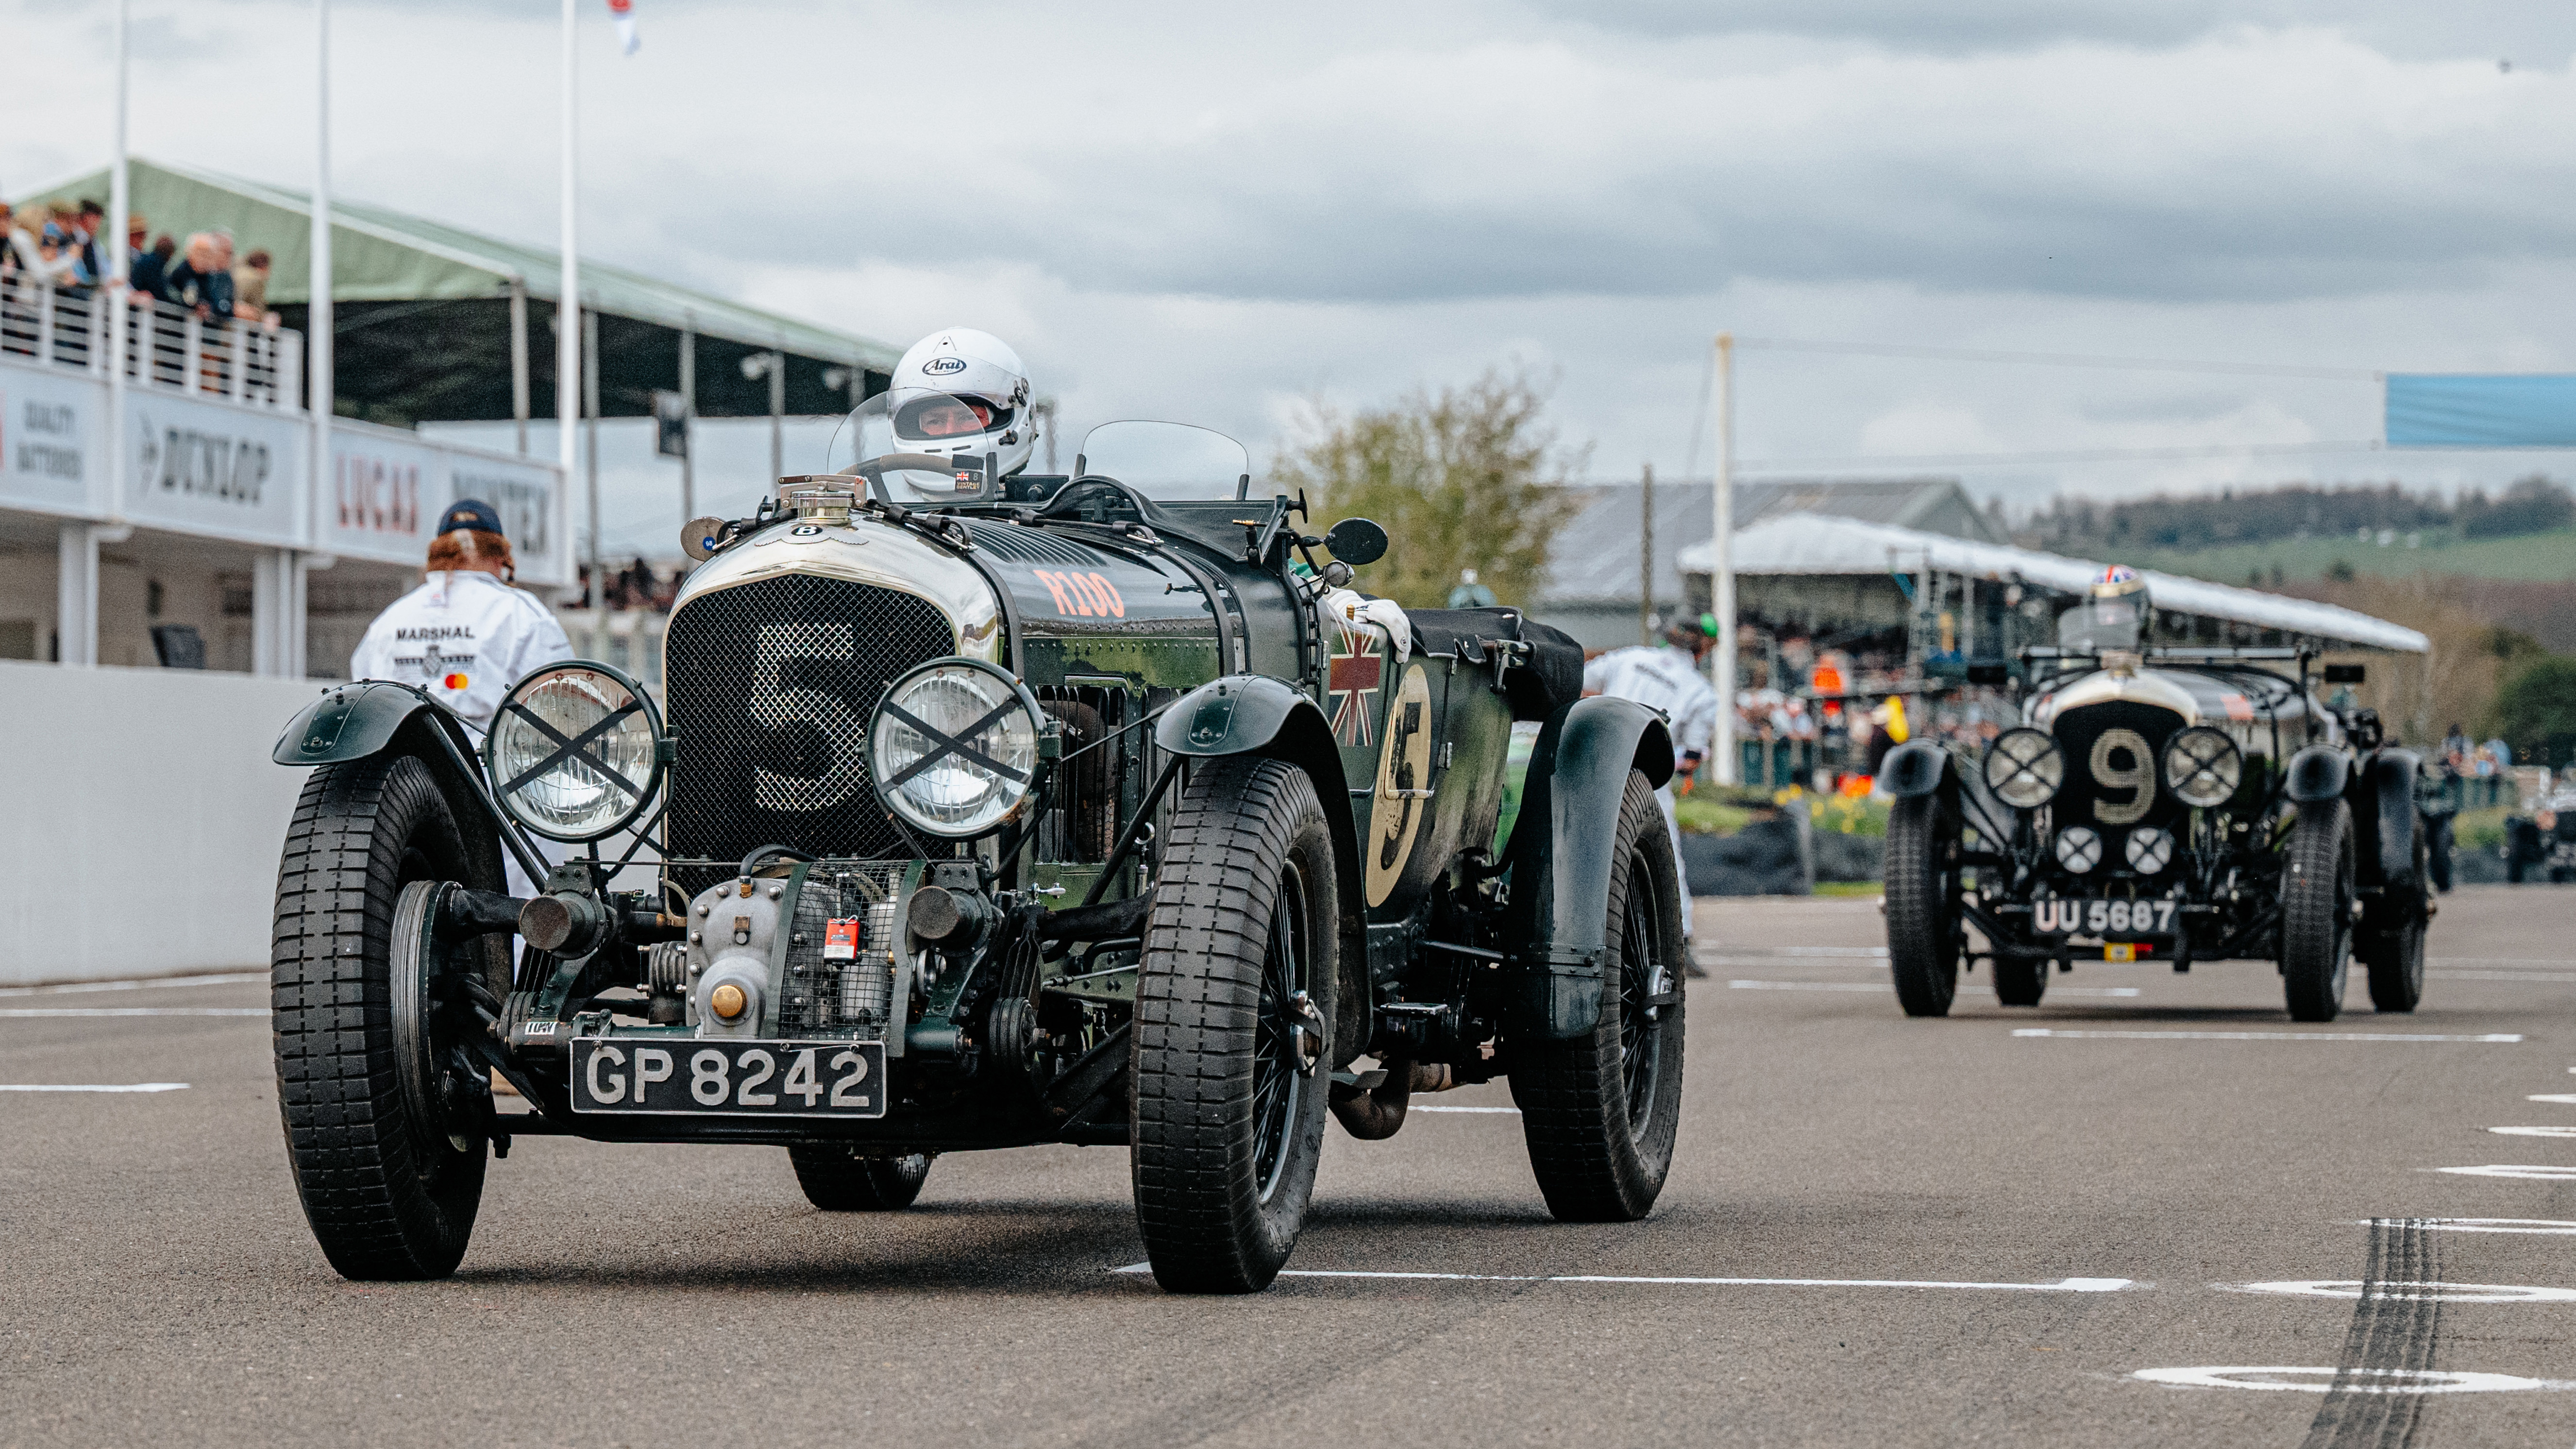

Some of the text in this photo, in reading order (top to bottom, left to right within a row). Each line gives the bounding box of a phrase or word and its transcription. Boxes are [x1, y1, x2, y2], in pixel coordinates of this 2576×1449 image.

[926, 359, 961, 371] Arai
[161, 427, 270, 501] DUNLOP
[336, 455, 418, 533] LUCAS
[796, 525, 817, 535] B
[1033, 570, 1125, 618] R100
[397, 626, 475, 640] MARSHAL
[751, 622, 864, 811] 5
[1381, 702, 1422, 871] 5
[2090, 728, 2157, 825] 9
[2035, 900, 2174, 931] UU 5687
[586, 1047, 869, 1107] GP 8242
